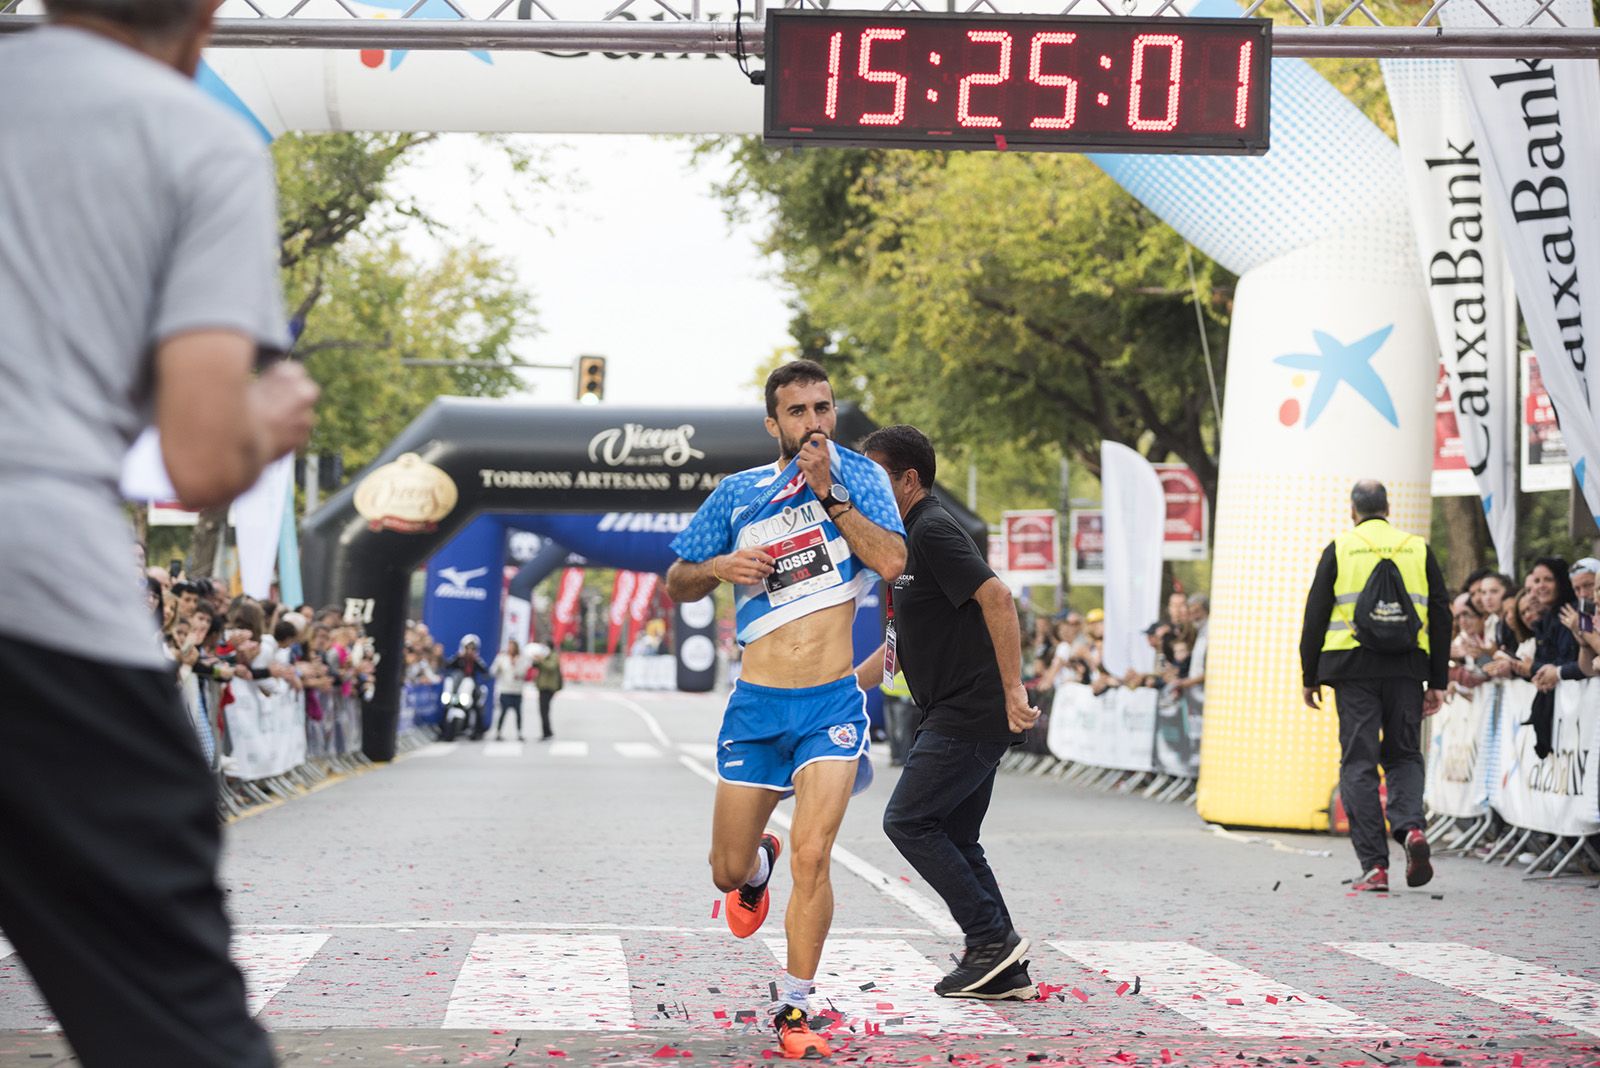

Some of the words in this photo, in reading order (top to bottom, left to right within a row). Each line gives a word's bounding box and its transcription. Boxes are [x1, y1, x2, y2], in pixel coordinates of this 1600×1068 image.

[479, 469, 572, 489] TORRONS
[574, 470, 671, 490] ARTESANS
[776, 550, 816, 574] JOSEP
